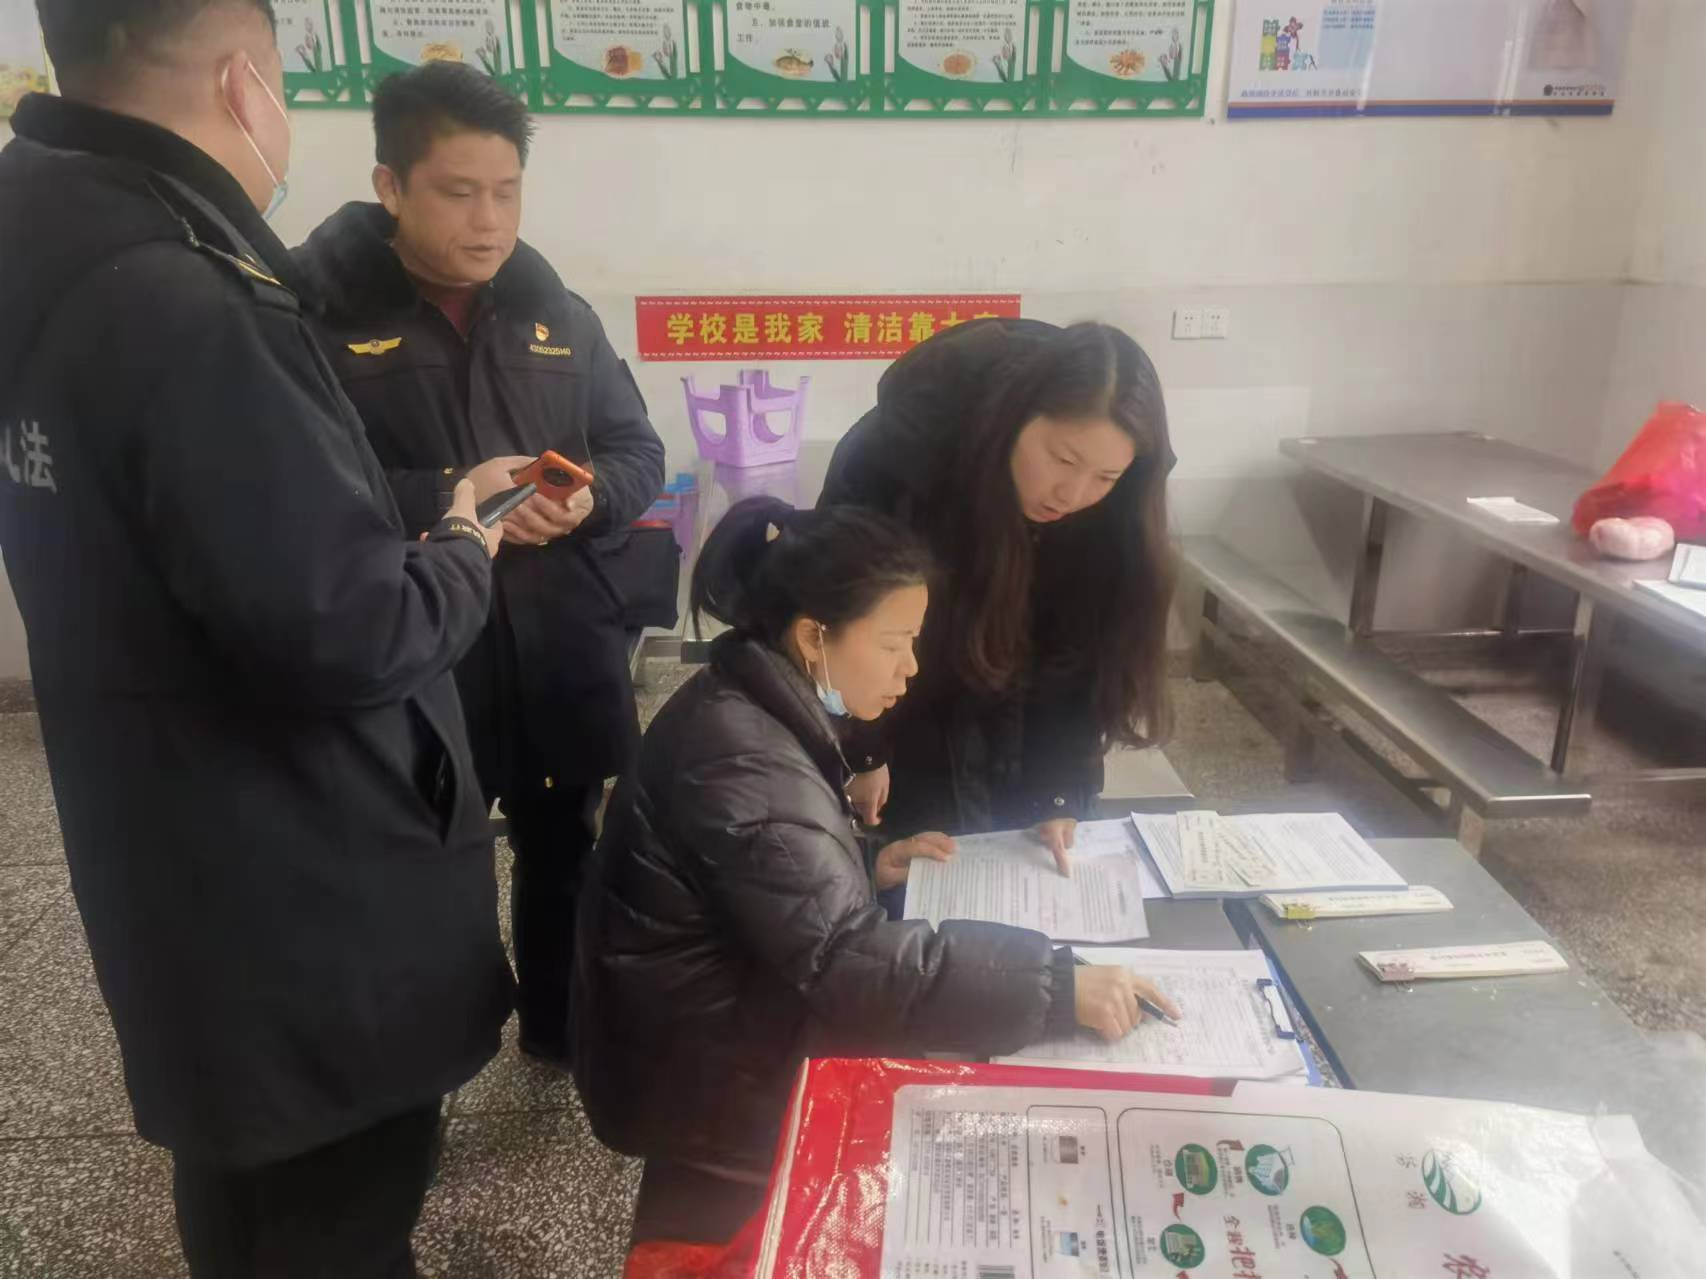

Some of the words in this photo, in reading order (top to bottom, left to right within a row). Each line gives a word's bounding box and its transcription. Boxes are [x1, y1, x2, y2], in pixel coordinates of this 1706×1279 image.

[666, 312, 825, 346] 学校是我家
